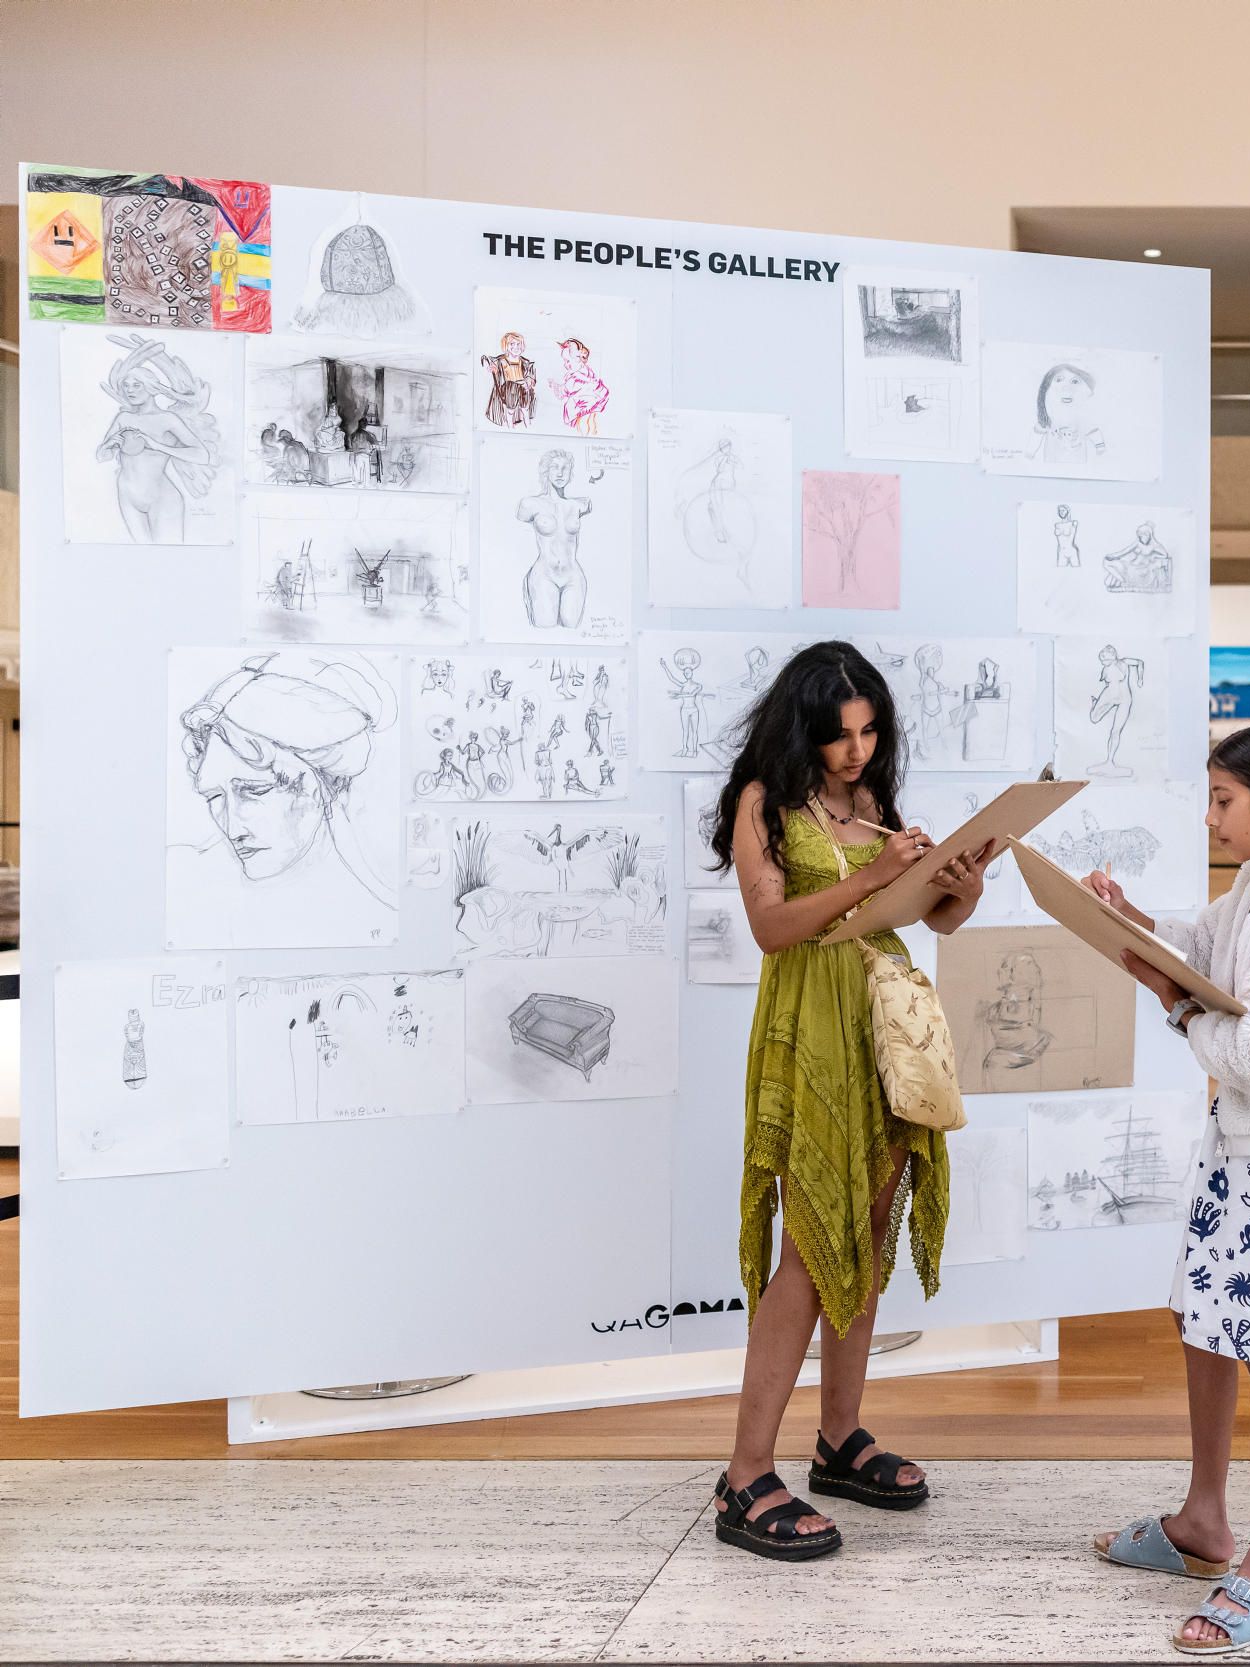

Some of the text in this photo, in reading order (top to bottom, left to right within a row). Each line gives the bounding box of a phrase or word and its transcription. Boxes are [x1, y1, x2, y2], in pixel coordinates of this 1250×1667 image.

[483, 232, 840, 283] THE PEOPLE'S GALLERY
[151, 974, 226, 1010] Ezra
[591, 1297, 745, 1334] QAGOMA
